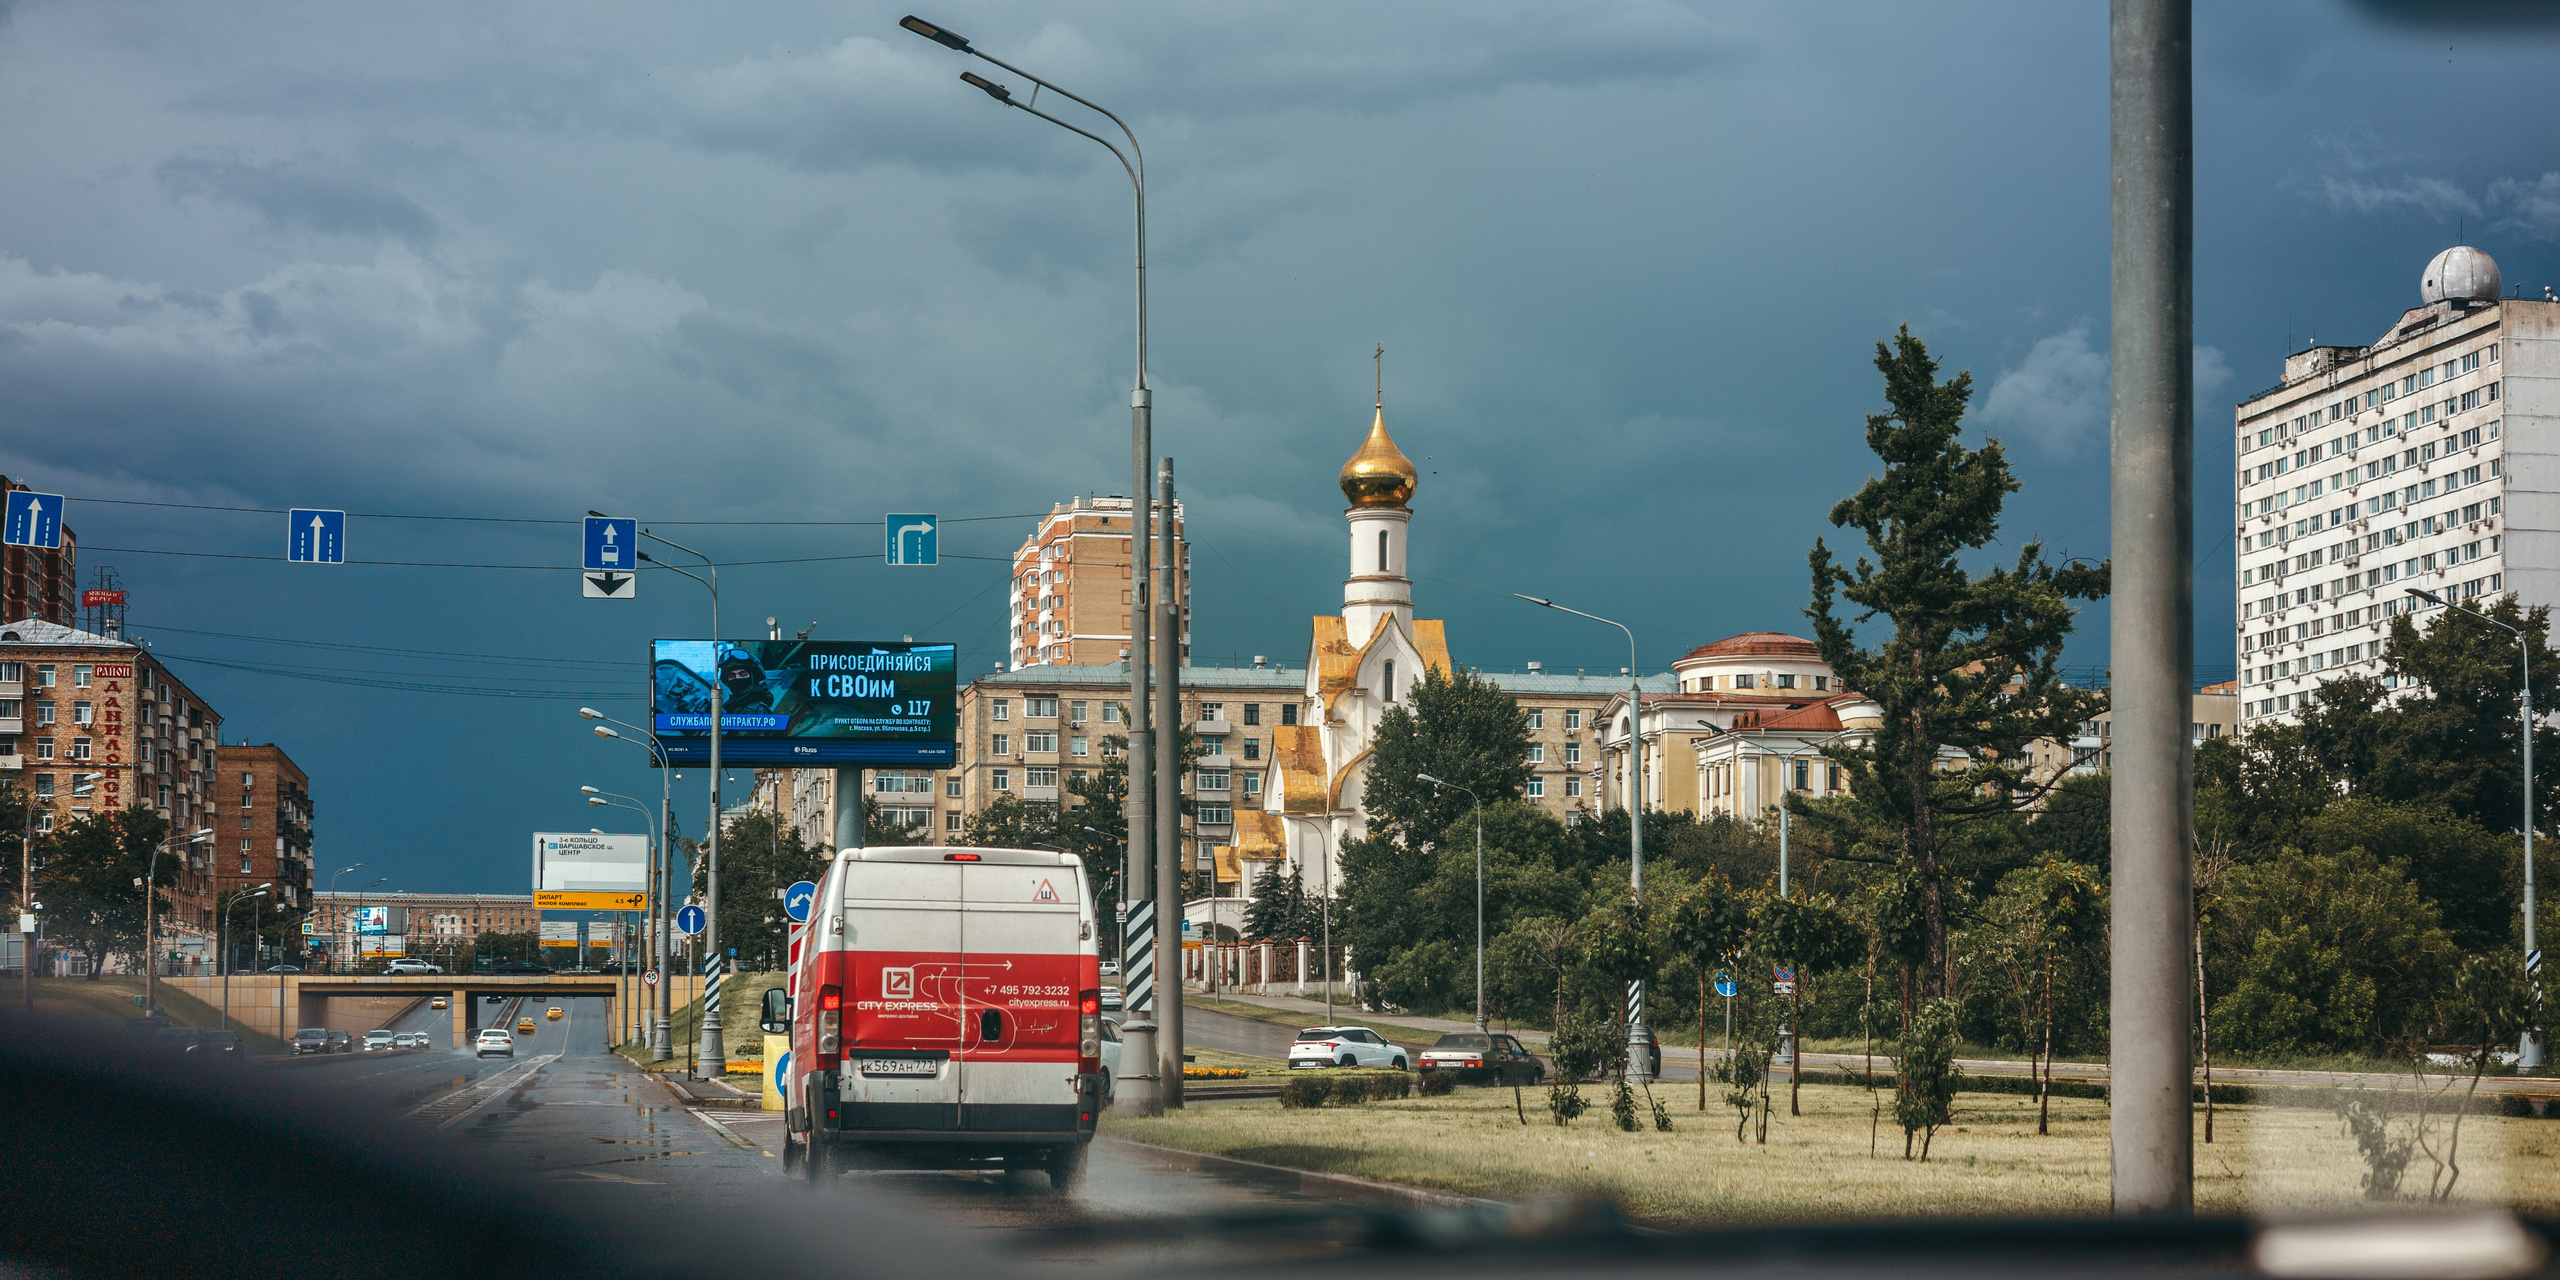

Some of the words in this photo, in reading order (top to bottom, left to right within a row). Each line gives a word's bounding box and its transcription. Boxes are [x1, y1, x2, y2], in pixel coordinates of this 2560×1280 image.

[810, 652, 931, 672] ПРИСОЕДИНЯЙСЯ
[96, 665, 130, 677] РАЙОН
[907, 700, 931, 716] 117
[670, 716, 776, 727] СЛУЖБАПОНТРАКТУ.РФ
[834, 717, 850, 725] ПУНКТ
[850, 717, 868, 725] ОТБОРА
[645, 972, 657, 980] 45
[984, 985, 997, 995] +7
[1000, 985, 1019, 995] 495
[1022, 985, 1070, 996] 792-3232
[857, 1001, 883, 1010] CITY
[885, 1001, 938, 1011] EXPRESS
[1008, 998, 1070, 1008] cityexpress.ru
